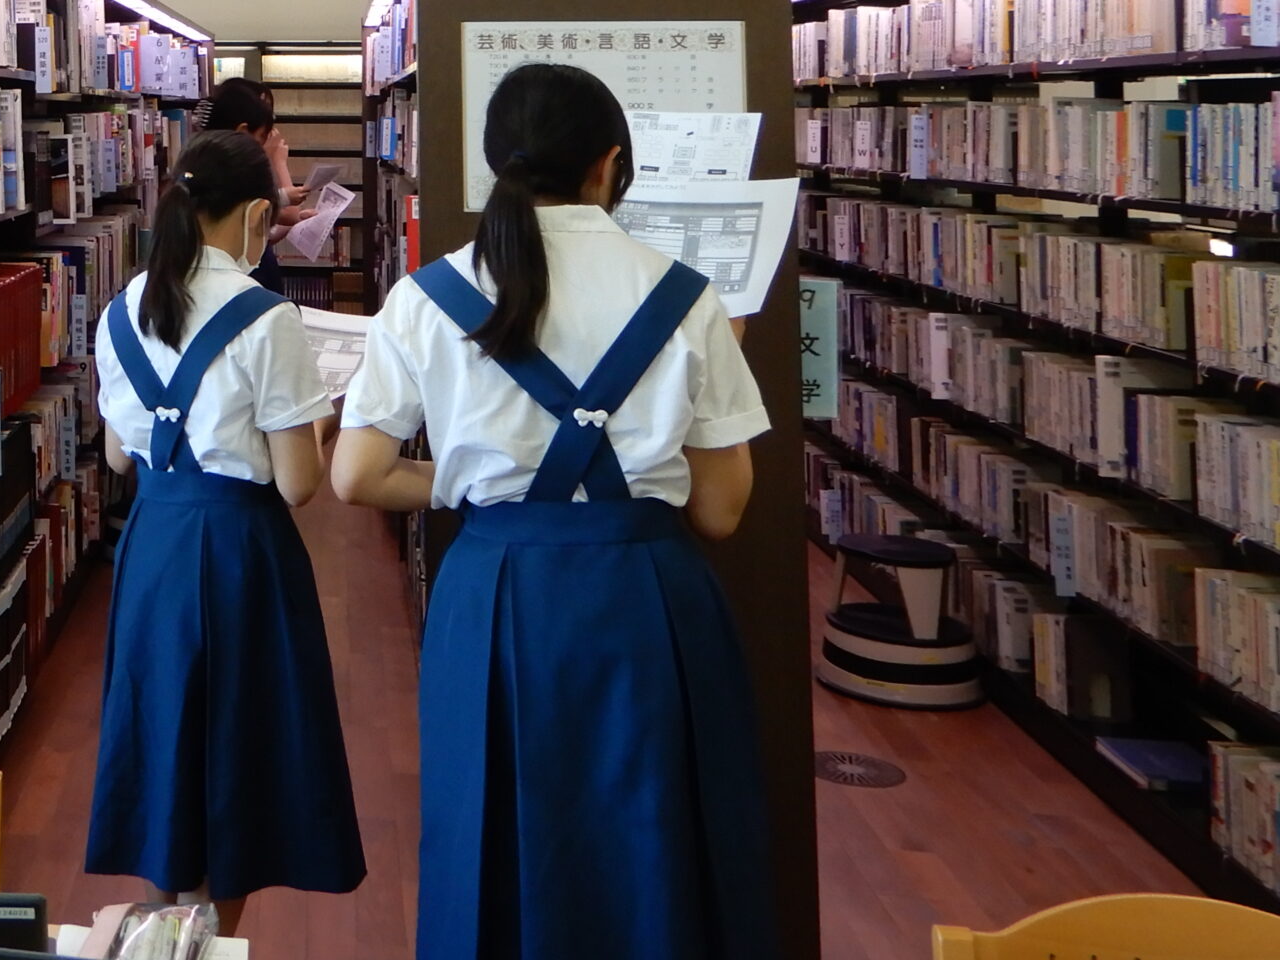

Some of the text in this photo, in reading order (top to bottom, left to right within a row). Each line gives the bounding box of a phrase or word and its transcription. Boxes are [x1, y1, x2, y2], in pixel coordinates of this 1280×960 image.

[39, 51, 48, 78] 建築学
[857, 149, 868, 157] W
